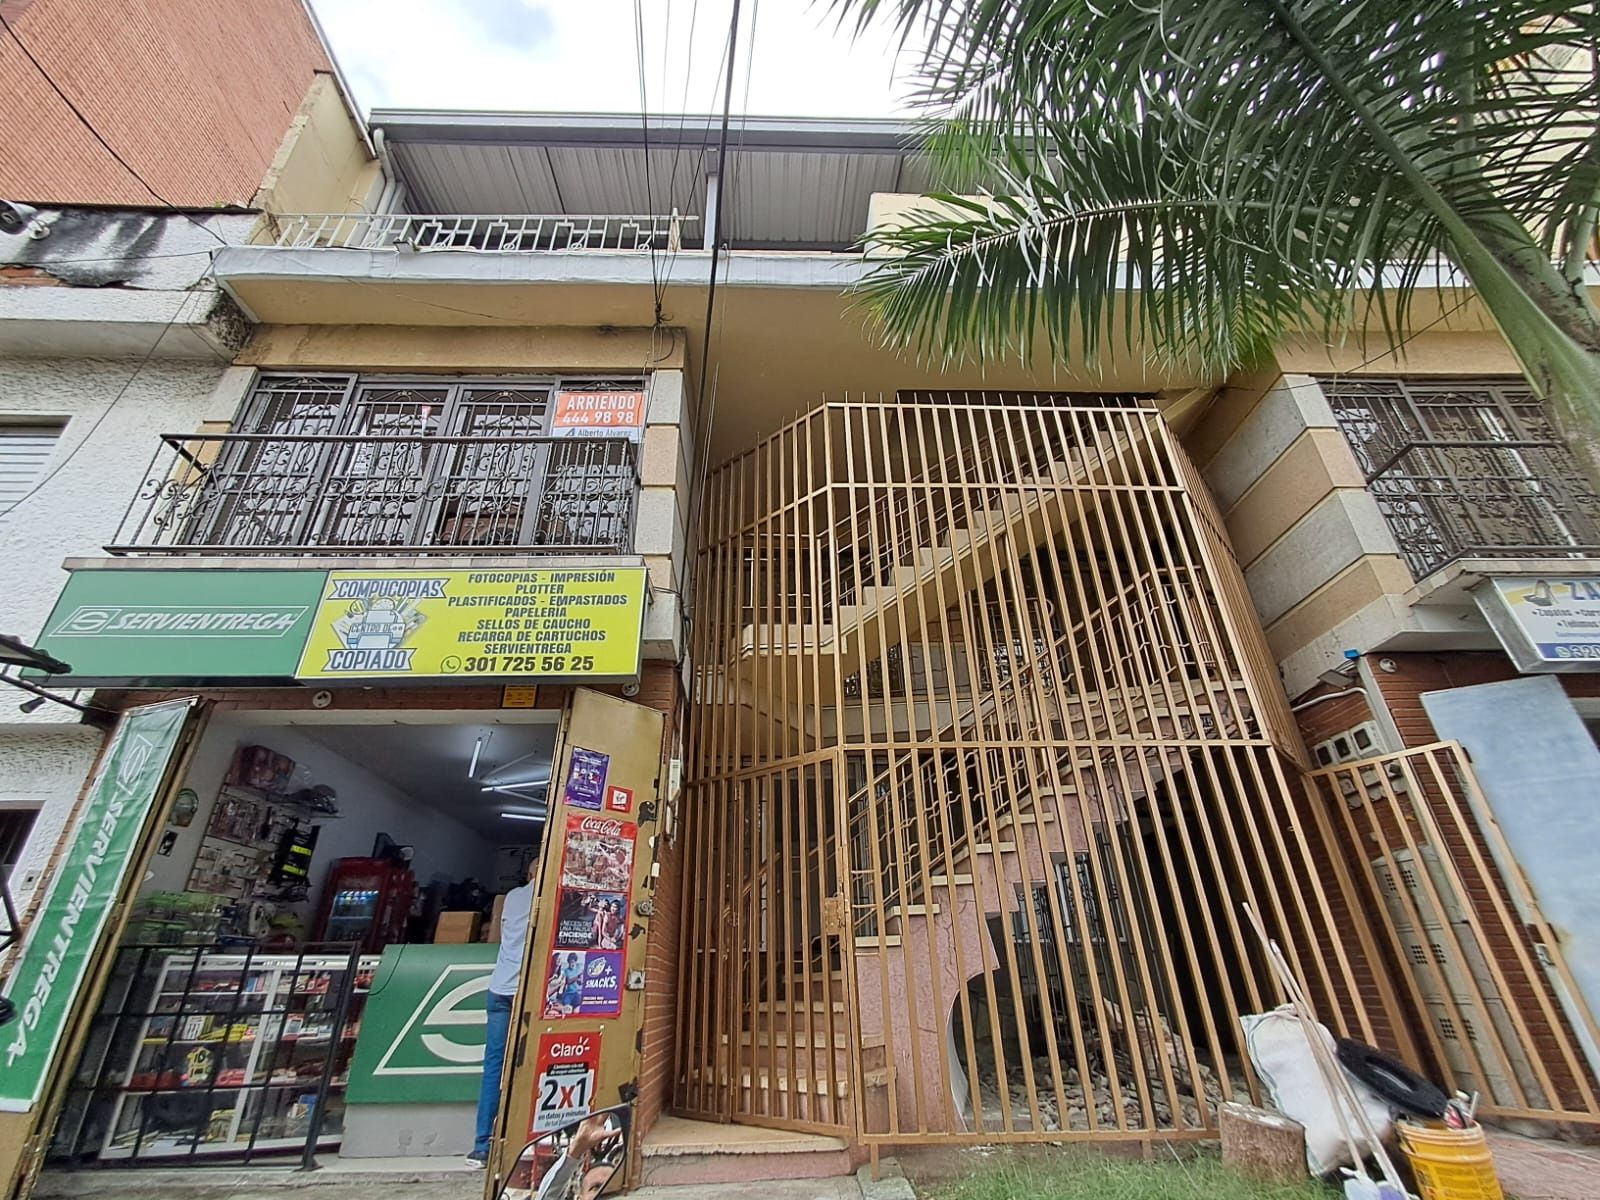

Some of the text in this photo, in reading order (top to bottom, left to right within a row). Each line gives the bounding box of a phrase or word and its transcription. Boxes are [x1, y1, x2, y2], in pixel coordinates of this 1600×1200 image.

[566, 395, 635, 410] ARRIENDO
[562, 411, 634, 424] 444 98 98
[577, 428, 604, 437] Alberto
[468, 572, 538, 584] FOTOCOPIAS
[550, 569, 615, 583] IMPRESIÓN
[338, 580, 442, 598] COMPUCOPIAS
[515, 584, 564, 594] PLOTTER
[1561, 581, 1600, 601] ZA
[448, 595, 537, 607] PLASTIFICADOS
[549, 594, 627, 606] EMPASTADOS
[106, 612, 297, 630] SERVIENTREGA
[476, 618, 591, 630] SELLOS DE CAUCHO
[457, 630, 606, 642] RECARGA DE CARTUCHOS
[484, 643, 572, 655] SERVIENTREGA
[330, 650, 408, 669] COPIADO
[464, 656, 594, 672] 301 725 56 25
[7, 791, 124, 1067] SERVIENTREGA
[550, 1042, 584, 1058] Claro
[540, 1077, 587, 1111] 2x1
[545, 1111, 562, 1120] datos
